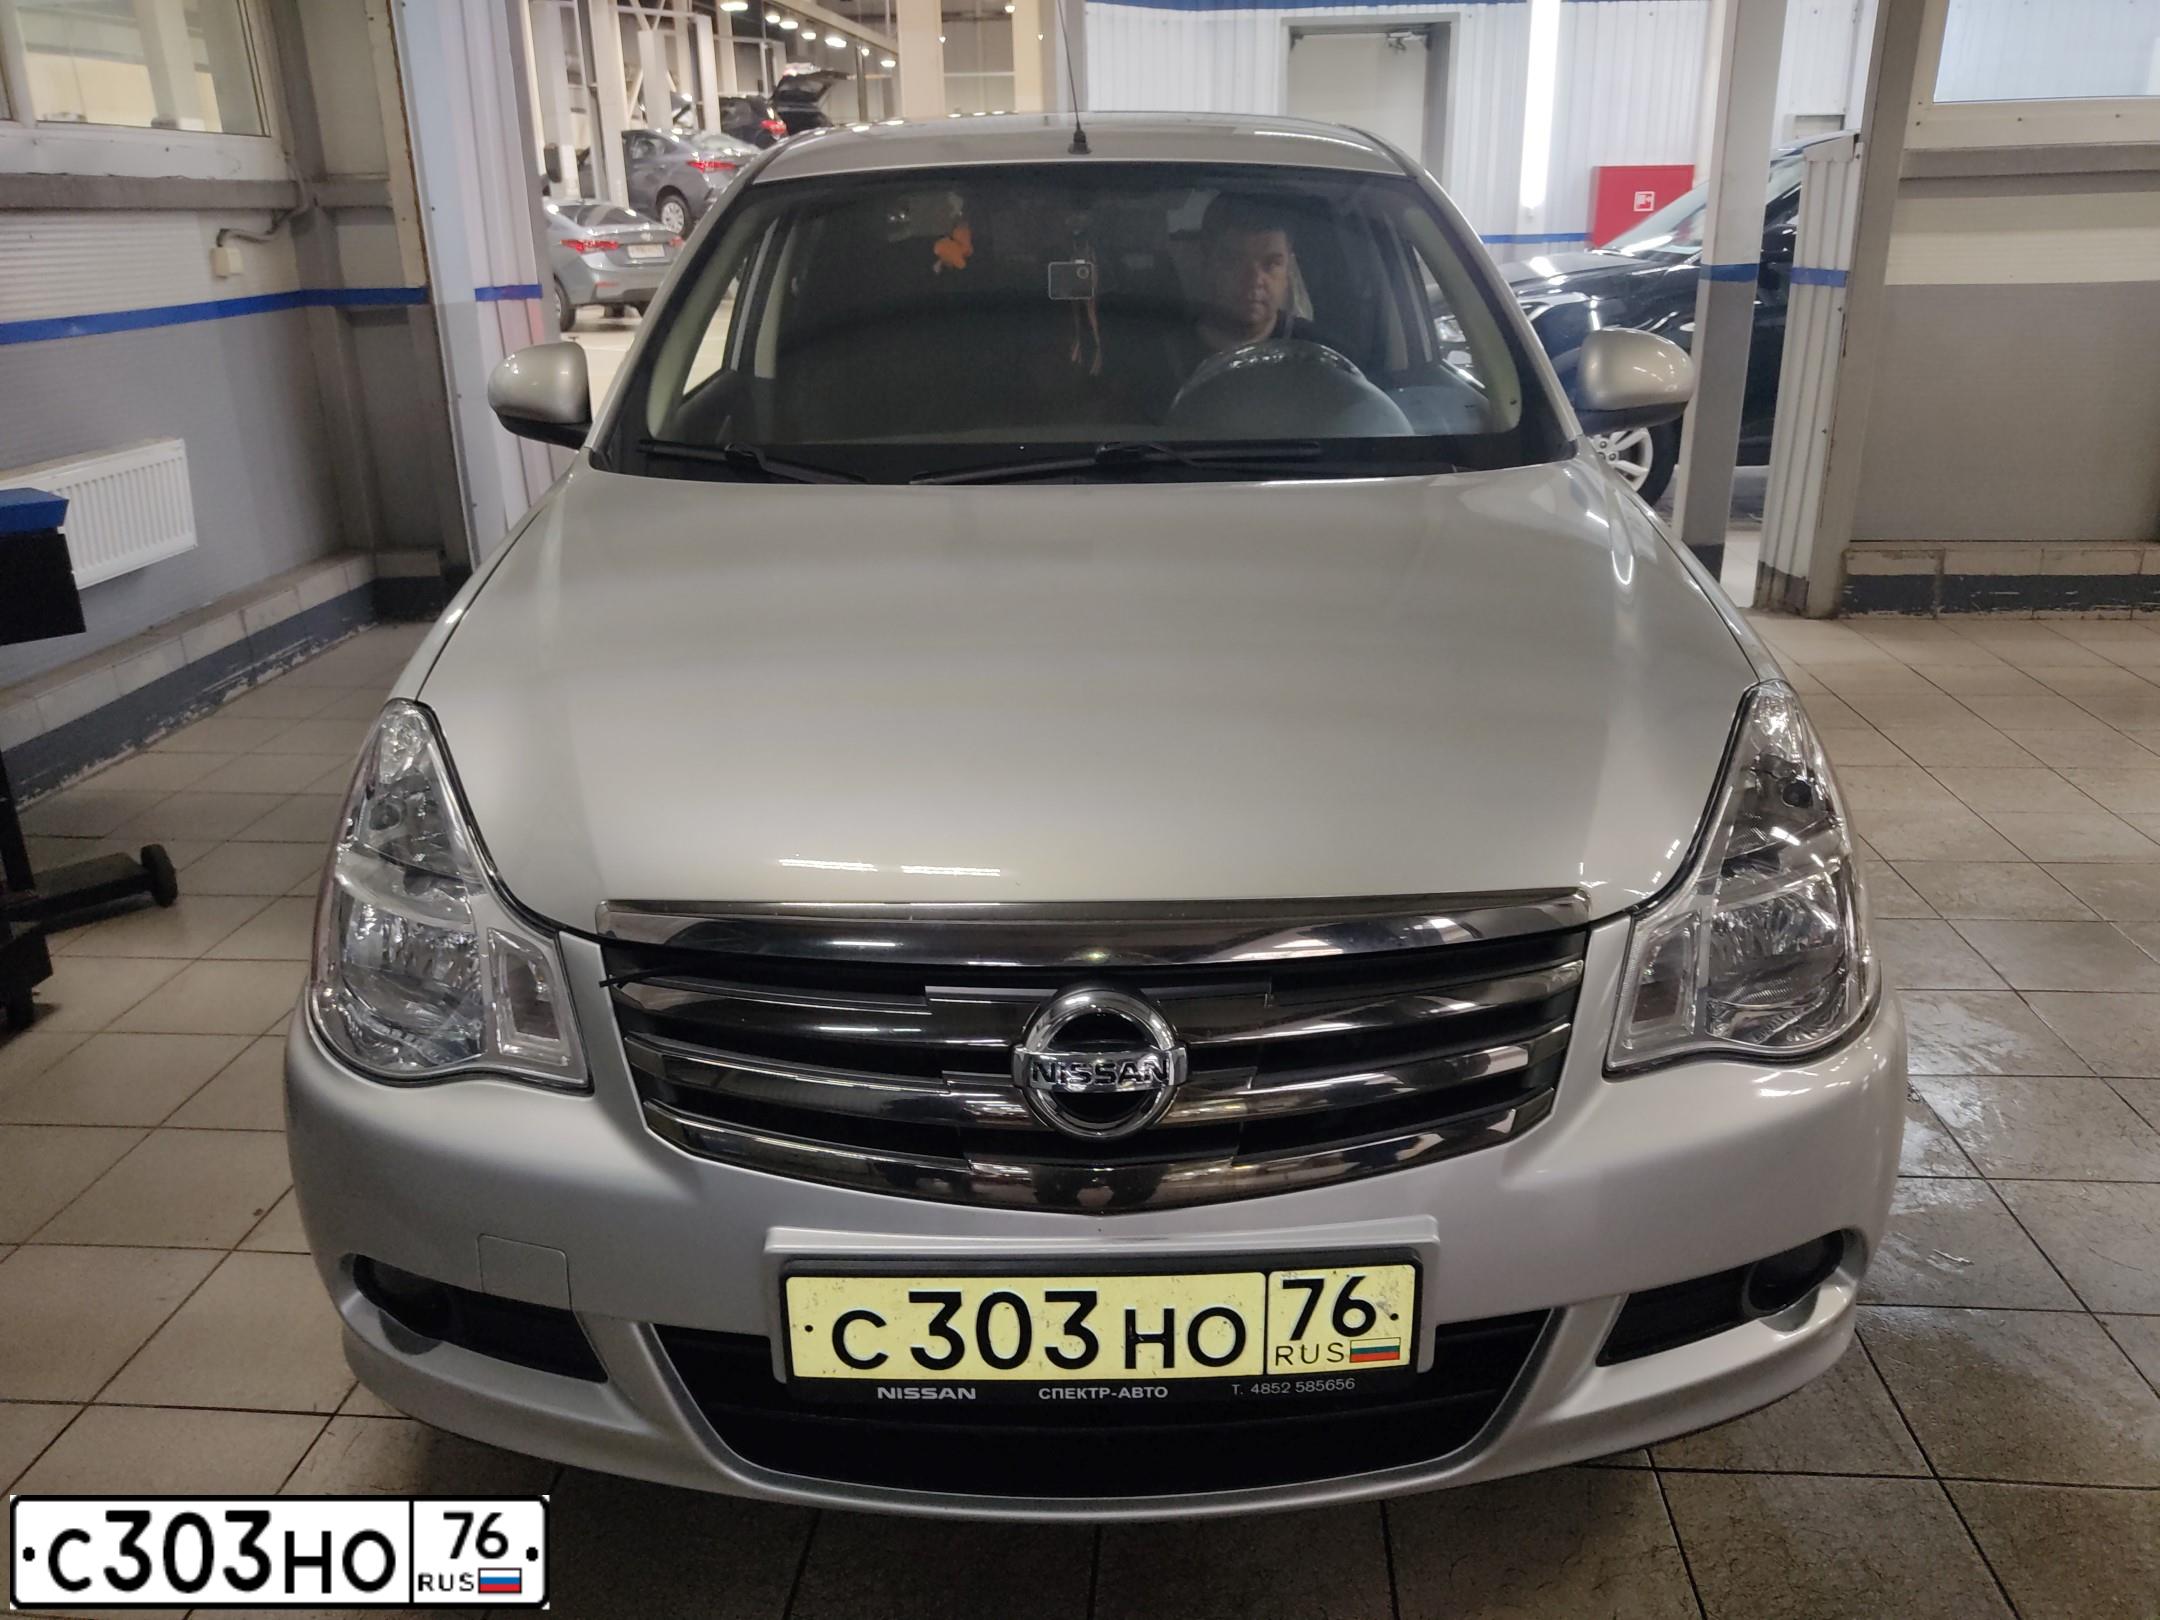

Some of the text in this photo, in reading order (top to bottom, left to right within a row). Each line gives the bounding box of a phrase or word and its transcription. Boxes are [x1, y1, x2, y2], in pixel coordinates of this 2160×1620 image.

[1031, 1061, 1168, 1085] NISSAN
[1282, 1275, 1377, 1341] 76
[1275, 1342, 1345, 1367] RUS
[877, 1386, 976, 1400] NISSAN
[1038, 1386, 1168, 1400] СПЕКТР-АВТО
[1250, 1381, 1292, 1395] 4852
[1295, 1377, 1356, 1393] 585656
